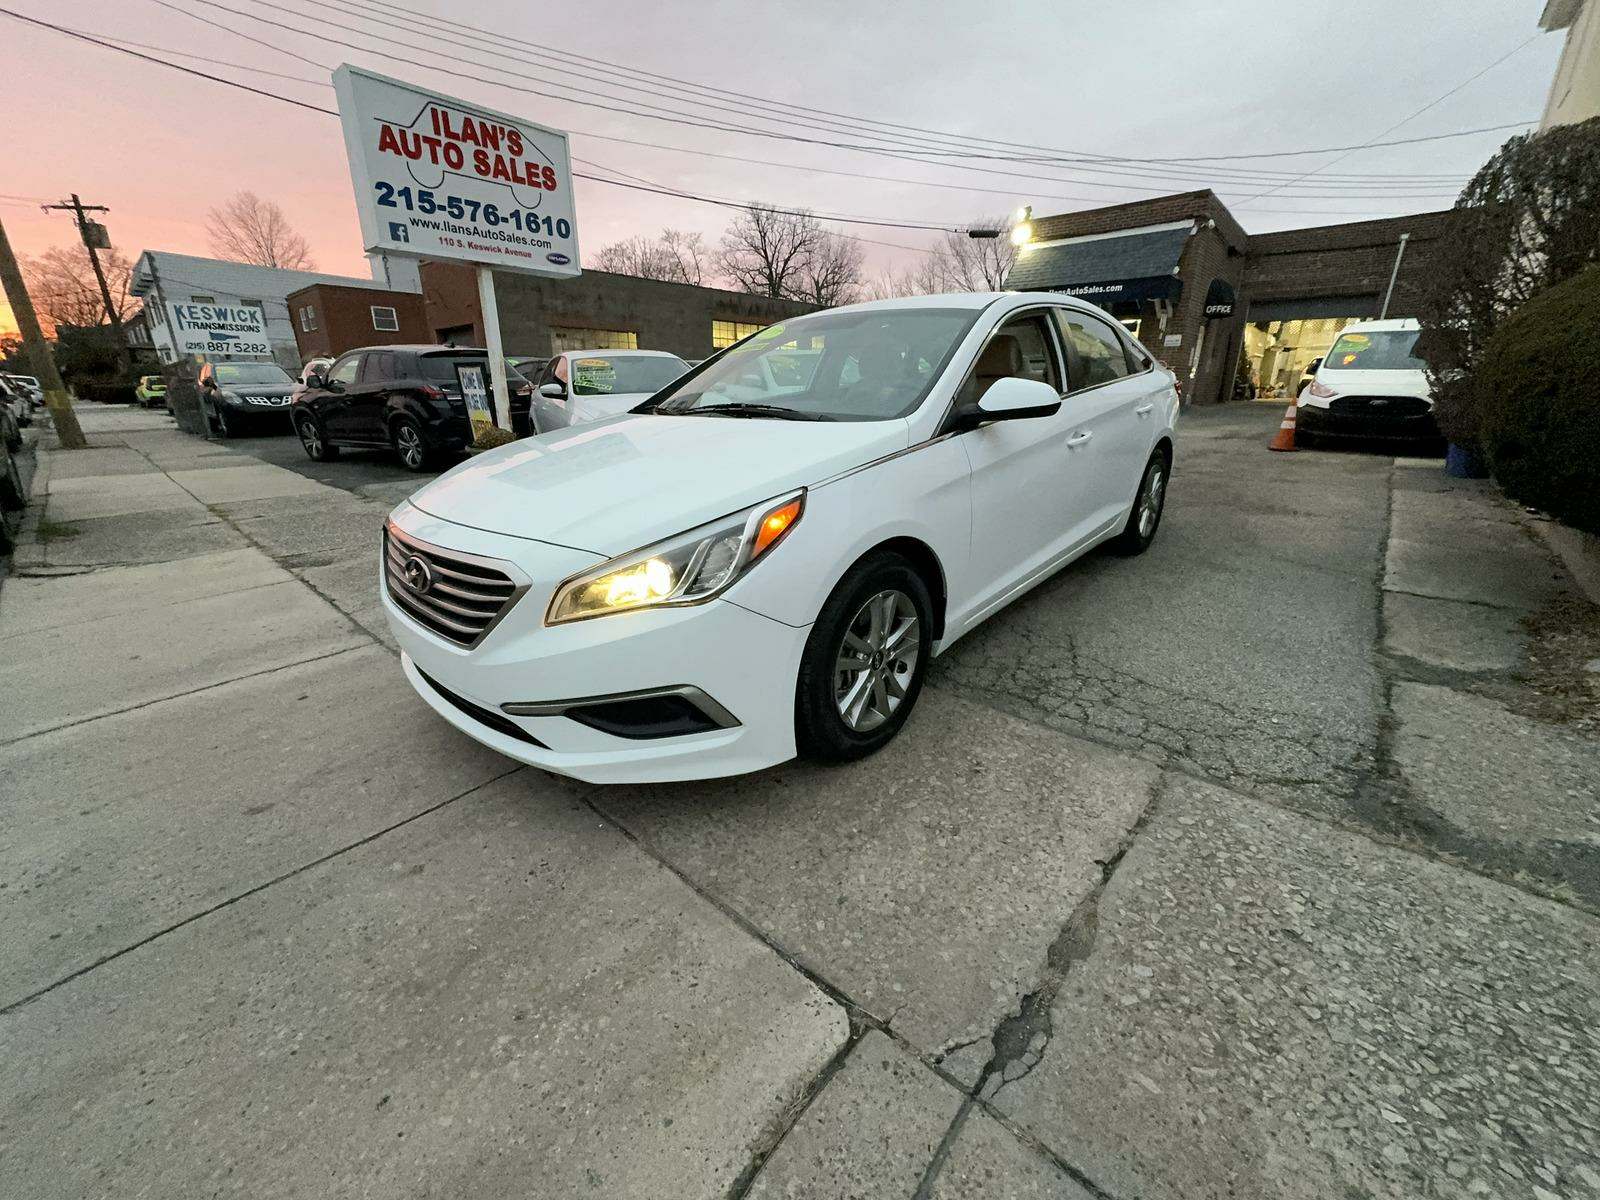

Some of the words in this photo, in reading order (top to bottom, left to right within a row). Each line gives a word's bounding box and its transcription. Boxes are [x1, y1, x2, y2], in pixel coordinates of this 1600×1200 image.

[431, 107, 524, 157] ILAN'S
[379, 124, 464, 170] AUTO
[473, 150, 557, 192] SALES
[375, 182, 570, 239] 215-576-1610
[409, 216, 551, 249] www.IlansAutoSales.com
[439, 236, 454, 247] 110
[457, 239, 465, 249] S.
[468, 241, 502, 254] Keswick
[504, 247, 532, 258] Avenue
[174, 305, 260, 330] KESWICK
[1206, 305, 1231, 313] OFFICE
[186, 321, 260, 333] TRANSMISSIONS
[185, 343, 205, 351] (215)
[208, 342, 229, 352] 887
[234, 343, 267, 353] 5282
